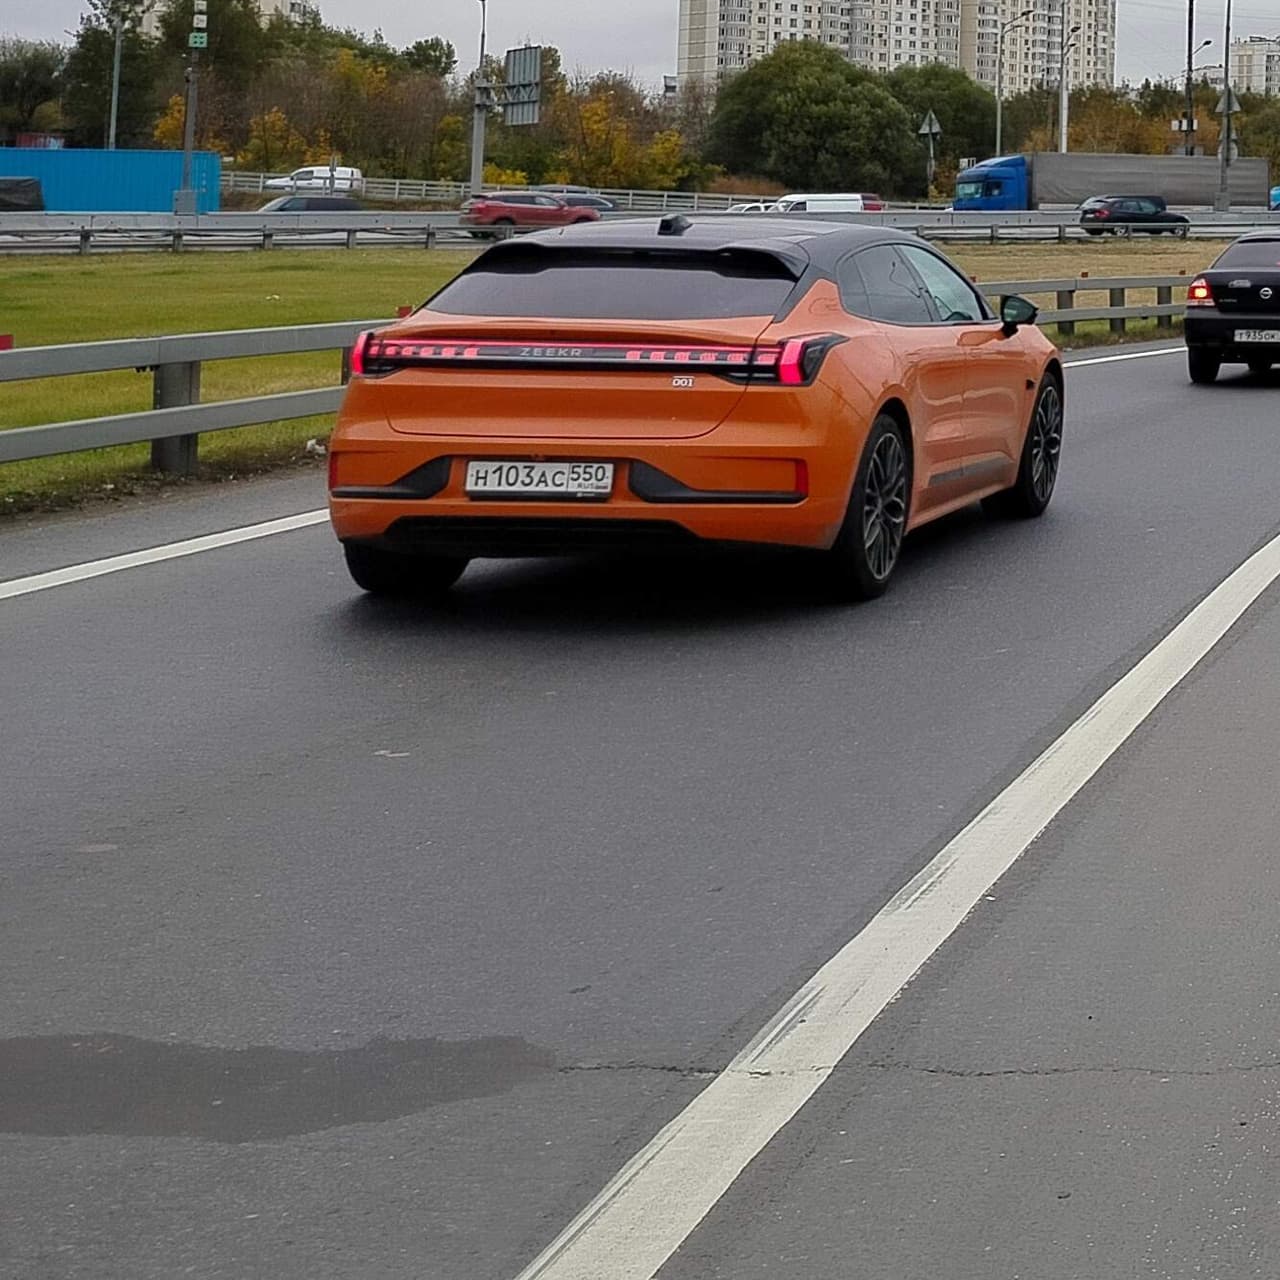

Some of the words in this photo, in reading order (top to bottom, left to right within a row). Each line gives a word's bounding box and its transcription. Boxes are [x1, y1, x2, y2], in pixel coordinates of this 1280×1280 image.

[519, 347, 582, 357] ZEEKR
[672, 376, 694, 387] 001
[474, 465, 566, 487] Н103АС
[570, 465, 606, 482] 550
